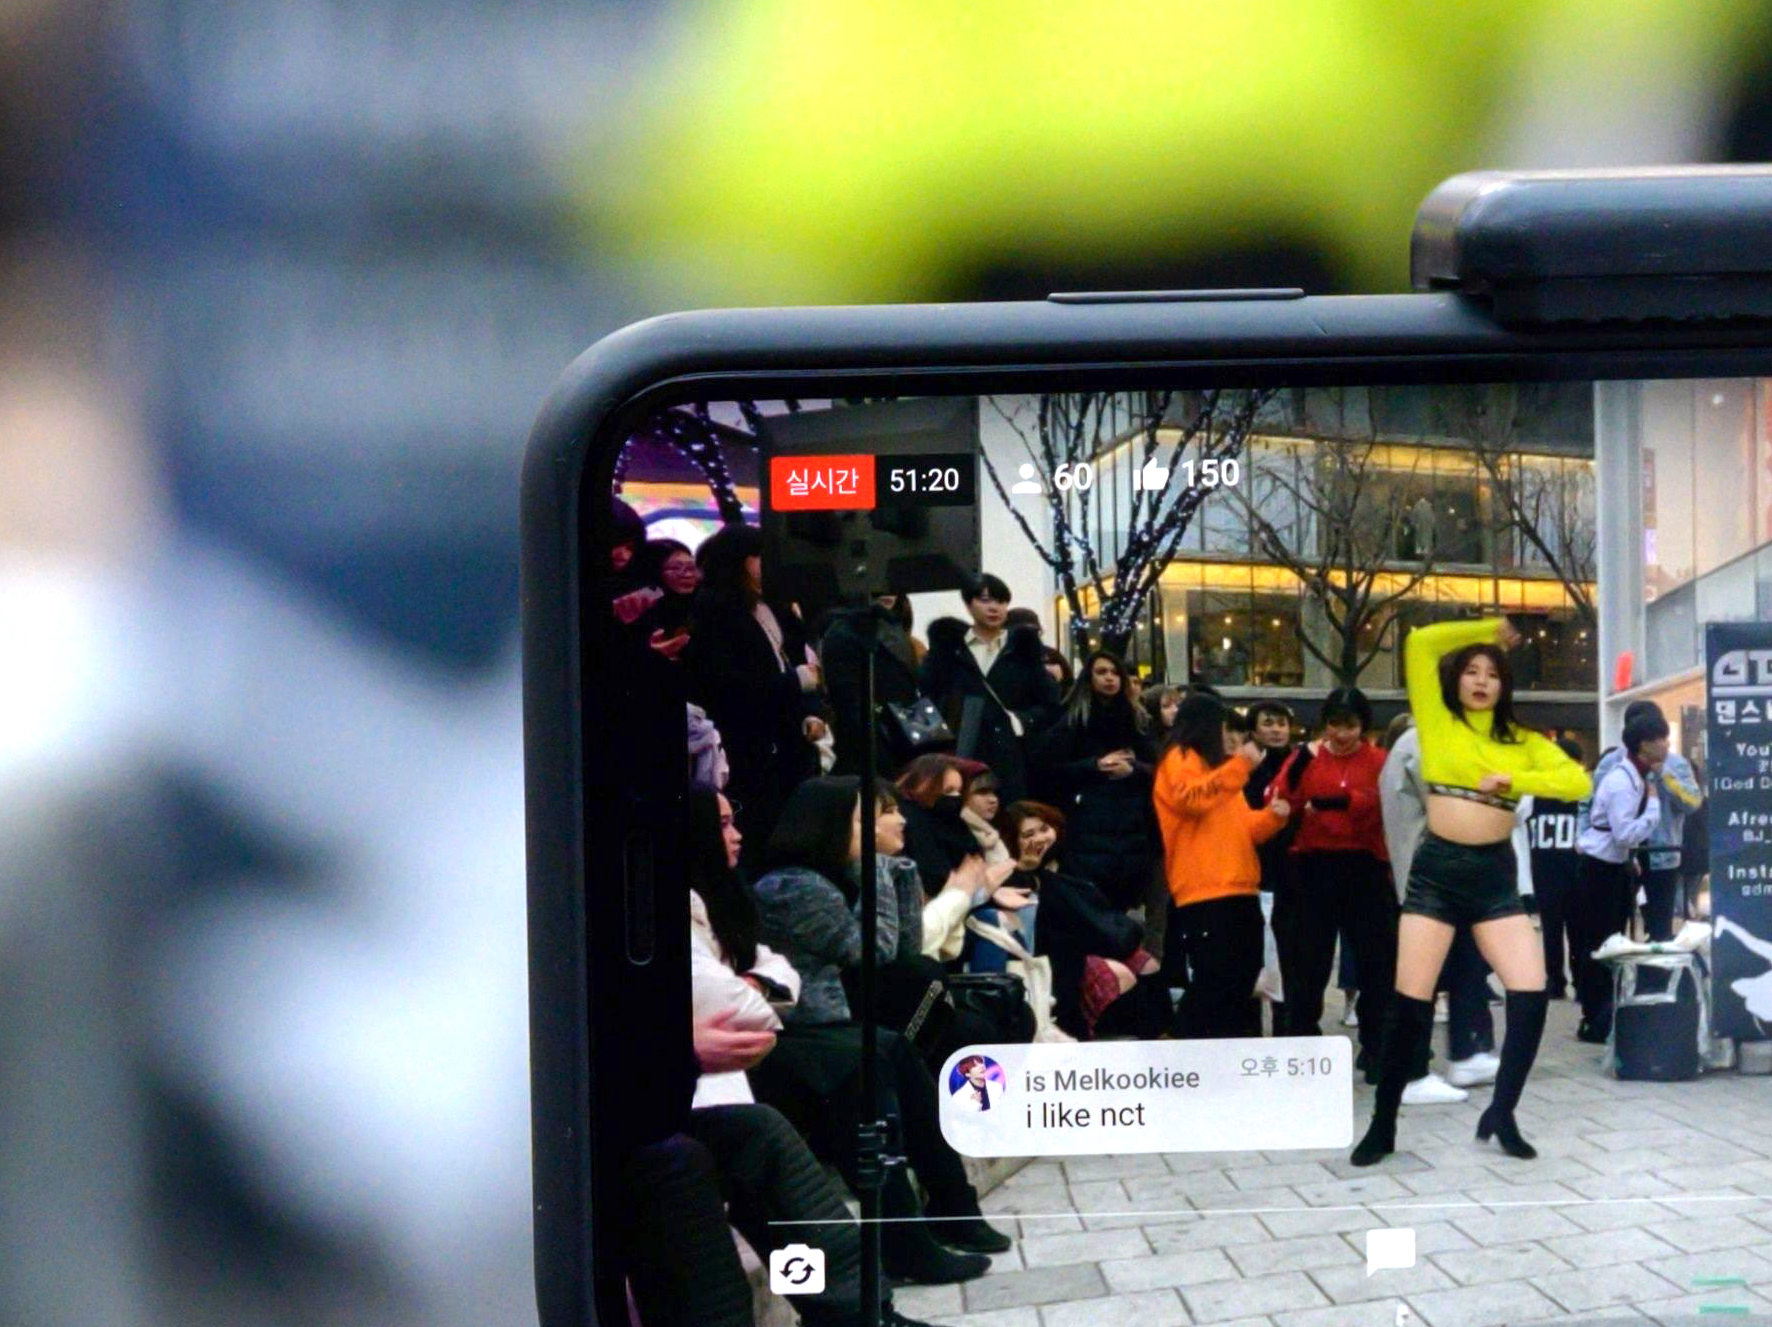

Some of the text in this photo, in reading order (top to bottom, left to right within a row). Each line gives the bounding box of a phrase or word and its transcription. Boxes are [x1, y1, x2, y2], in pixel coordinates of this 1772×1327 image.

[786, 467, 859, 496] 실시간
[889, 468, 960, 492] 51:20
[1052, 463, 1093, 492] 60
[1180, 459, 1240, 488] 150
[1025, 1067, 1201, 1092] is Melkookiee
[1240, 1056, 1333, 1078] 오후 5:10
[1026, 1102, 1146, 1129] i like nct
